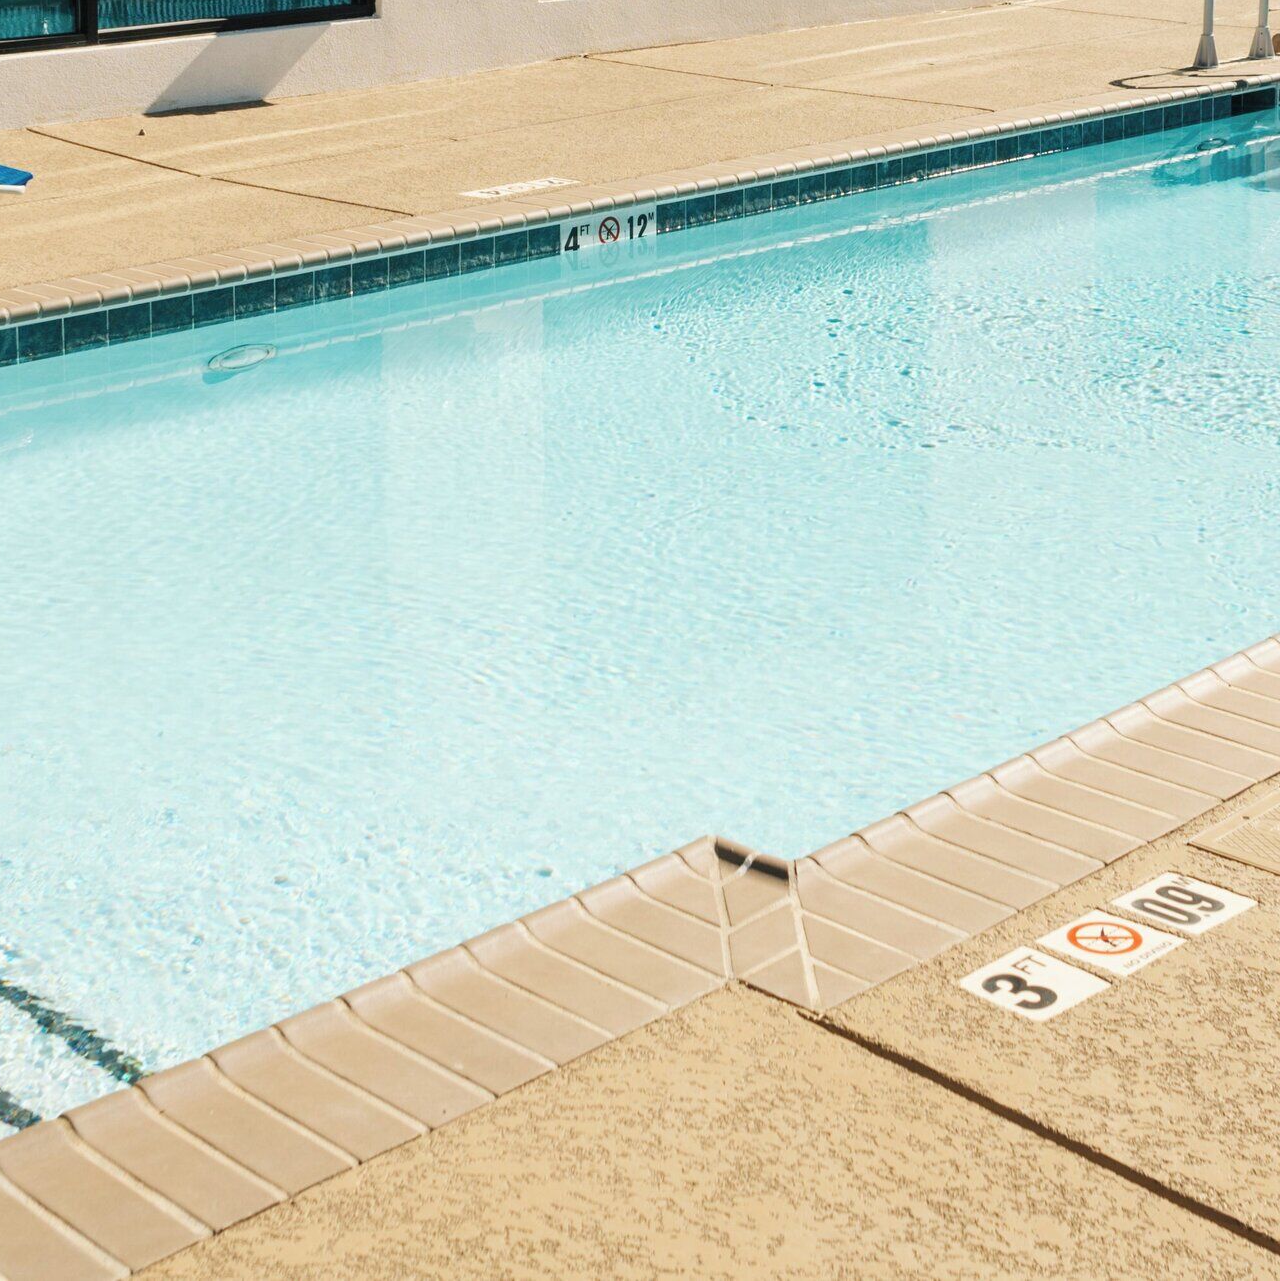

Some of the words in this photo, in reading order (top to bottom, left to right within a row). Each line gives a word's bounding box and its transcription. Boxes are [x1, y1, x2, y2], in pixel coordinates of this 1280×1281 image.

[564, 226, 580, 252] 4
[627, 213, 648, 241] 12
[1010, 954, 1048, 976] FT
[981, 973, 1058, 1010] 3
